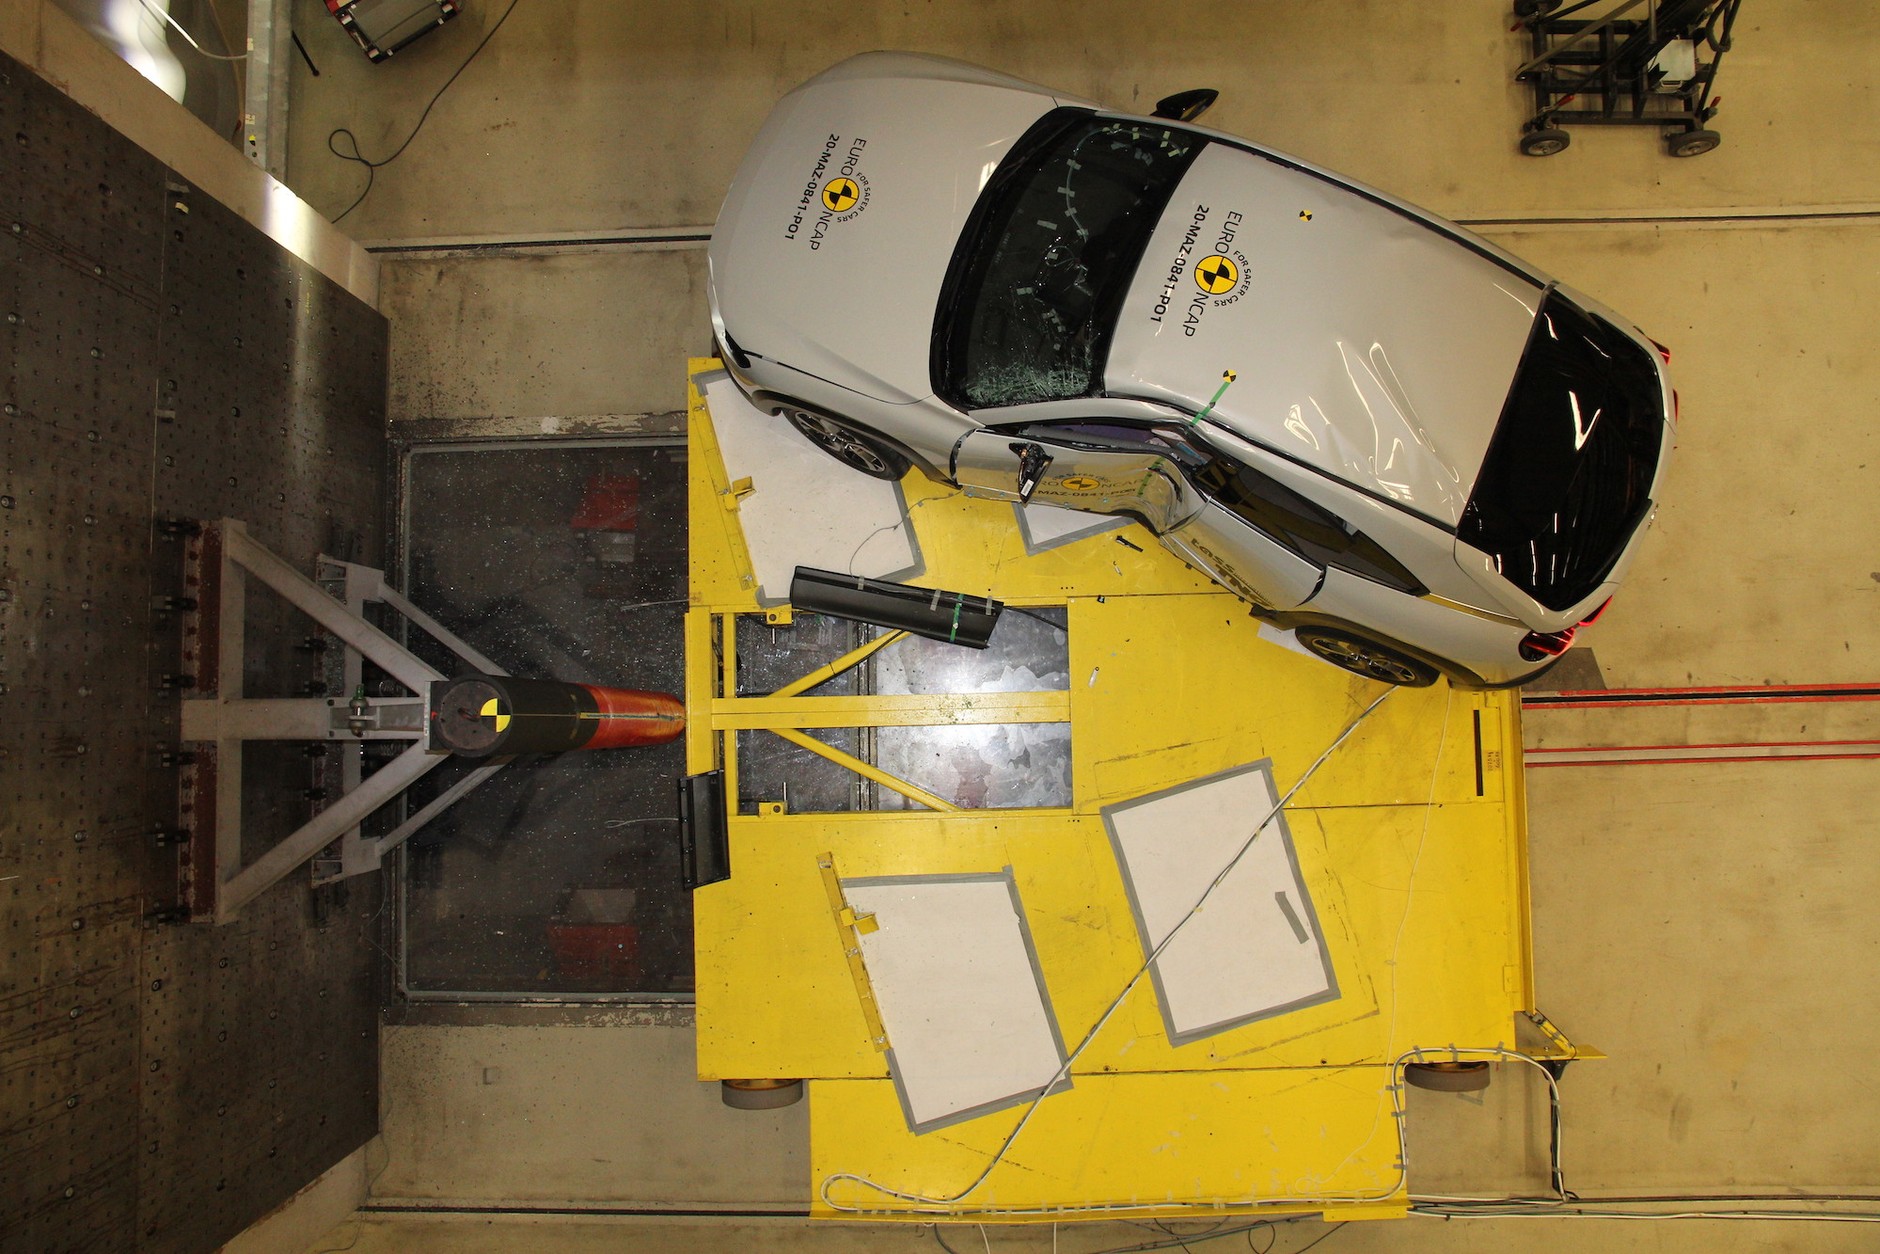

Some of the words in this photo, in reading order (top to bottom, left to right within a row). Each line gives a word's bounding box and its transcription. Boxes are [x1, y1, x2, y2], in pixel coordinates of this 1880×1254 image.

[840, 138, 867, 177] EURO
[856, 172, 869, 186] FOR
[862, 187, 871, 212] SAFER
[809, 211, 834, 250] NCAP
[837, 211, 859, 223] CARS
[1214, 210, 1243, 255] EURO
[1233, 250, 1249, 267] FOR
[1236, 268, 1252, 297] SAFER
[1182, 292, 1210, 337] NCAP
[1214, 295, 1239, 308] CARS
